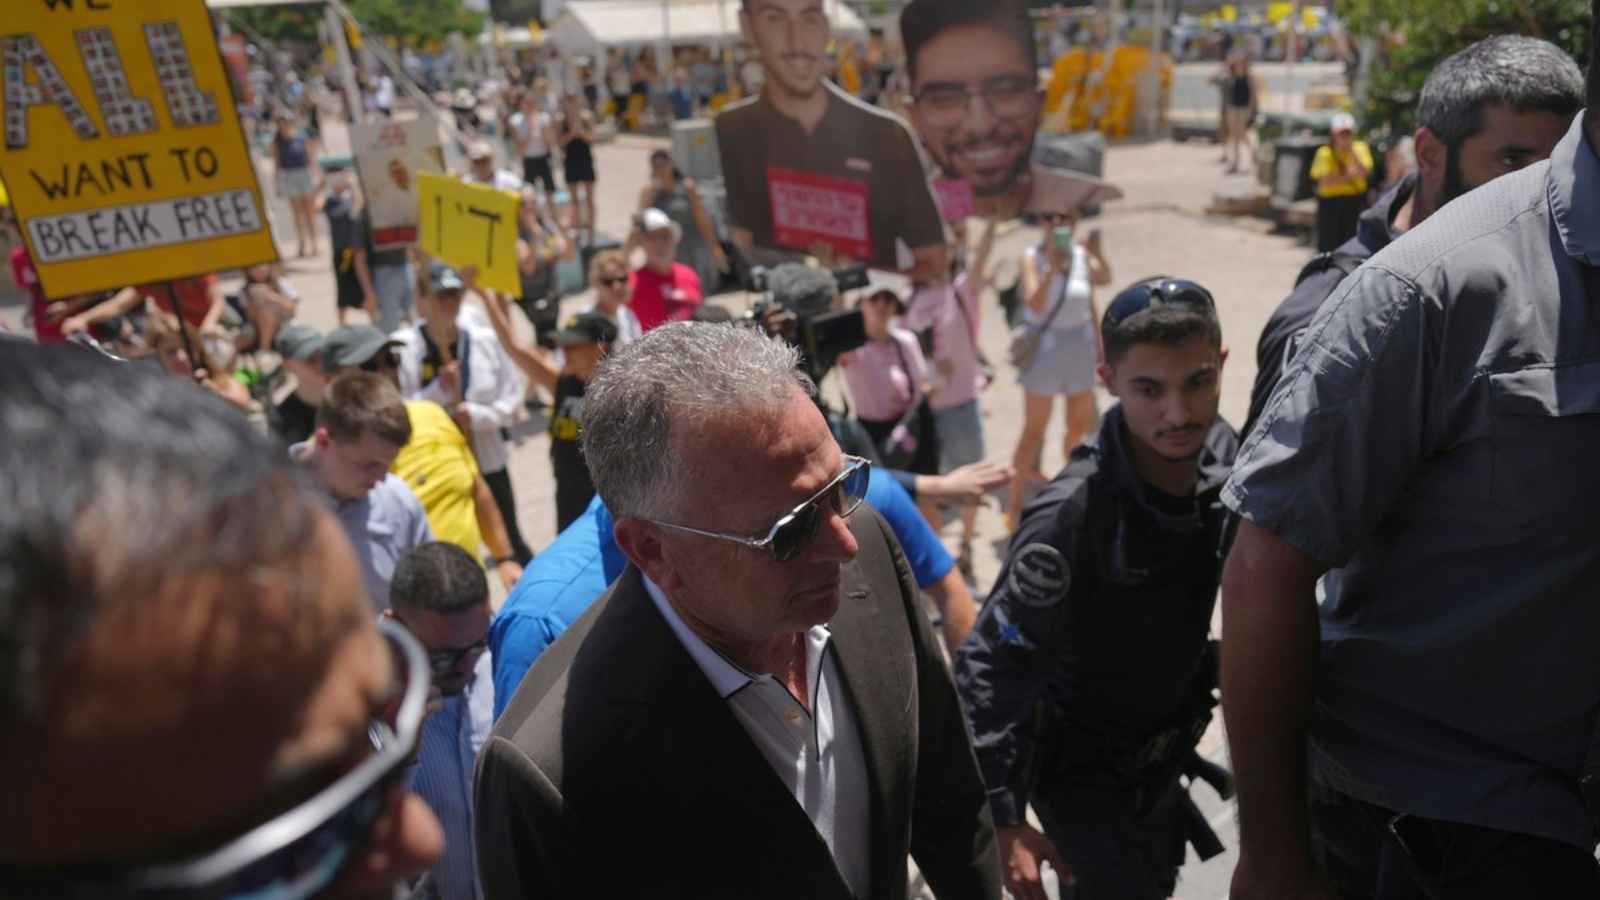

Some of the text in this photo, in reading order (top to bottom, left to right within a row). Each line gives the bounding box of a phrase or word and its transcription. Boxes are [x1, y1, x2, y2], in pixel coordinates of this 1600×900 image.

[2, 21, 220, 148] ALL
[30, 147, 218, 199] WANT TO
[36, 193, 250, 257] BREAK FREE
